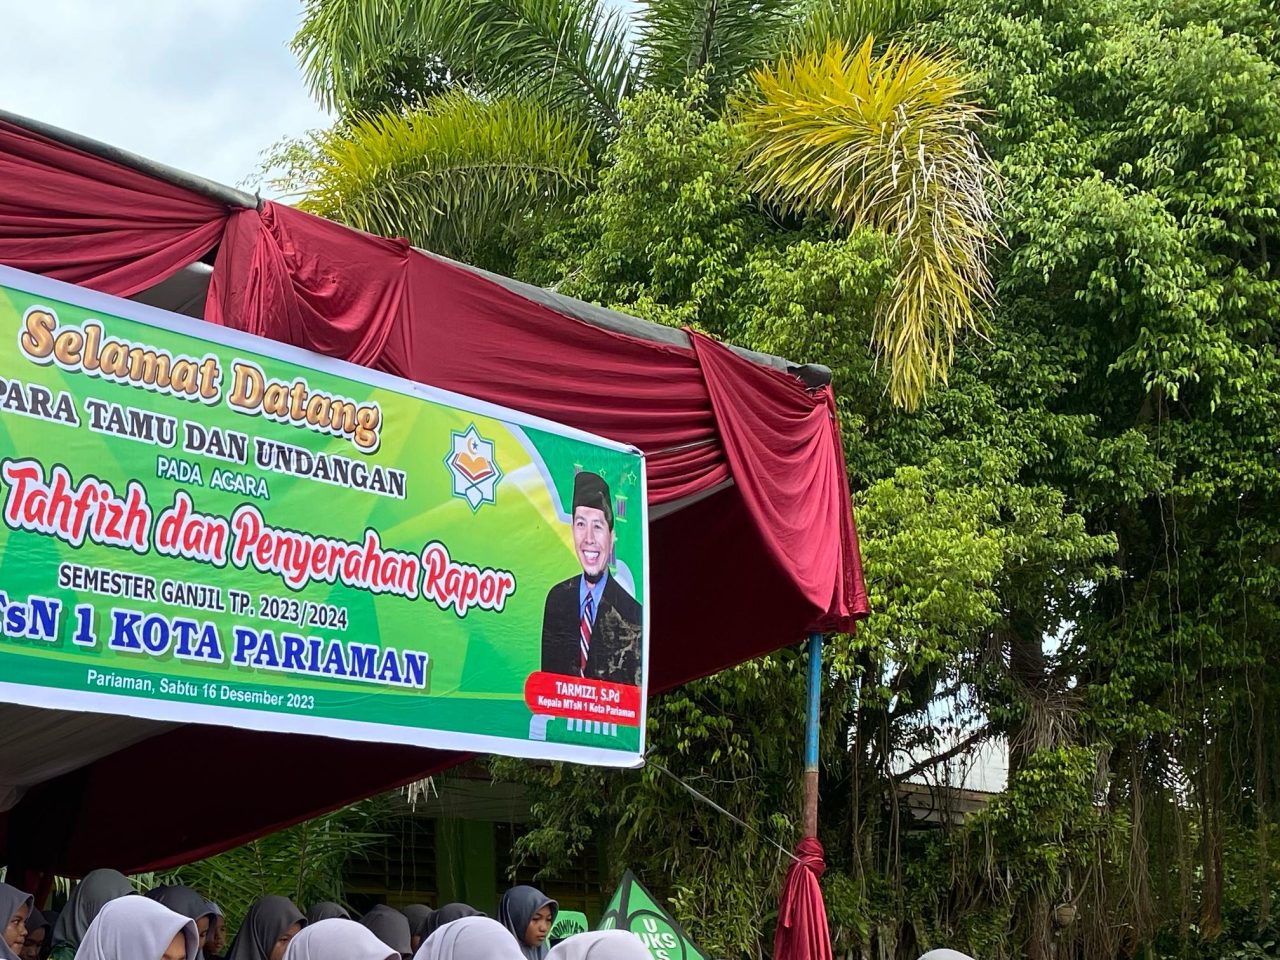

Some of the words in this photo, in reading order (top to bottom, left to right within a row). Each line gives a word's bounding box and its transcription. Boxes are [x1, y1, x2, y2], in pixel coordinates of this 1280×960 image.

[22, 310, 219, 400] Selamat
[228, 363, 382, 449] Datang
[88, 401, 176, 445] TAMU
[185, 423, 247, 464] DAN
[257, 441, 406, 498] UNDANGAN
[157, 456, 203, 487] PADA
[211, 469, 270, 500] ACARA
[4, 463, 150, 551] Tahfizh
[157, 494, 225, 563] dan
[233, 507, 418, 595] Penyerahan
[423, 545, 515, 612] Rapor
[59, 564, 156, 600] SEMESTER
[162, 582, 225, 611] GANJIL
[229, 591, 255, 616] TP.
[260, 596, 348, 628] 2023/2024
[75, 607, 95, 643] 1
[111, 610, 223, 660] KOTA
[233, 629, 427, 687] PARIAMAN
[87, 669, 156, 694] Pariaman,
[159, 677, 198, 698] Sabtu
[202, 682, 218, 699] 16
[221, 686, 284, 706] Desember
[286, 692, 315, 710] 2023
[538, 695, 562, 709] Kepala
[563, 699, 582, 711] MTsN
[583, 702, 588, 710] 1
[589, 703, 605, 714] Kota
[606, 705, 636, 719] Pariaman
[556, 681, 598, 703] TARMIZI,
[600, 688, 620, 703] S.Pd
